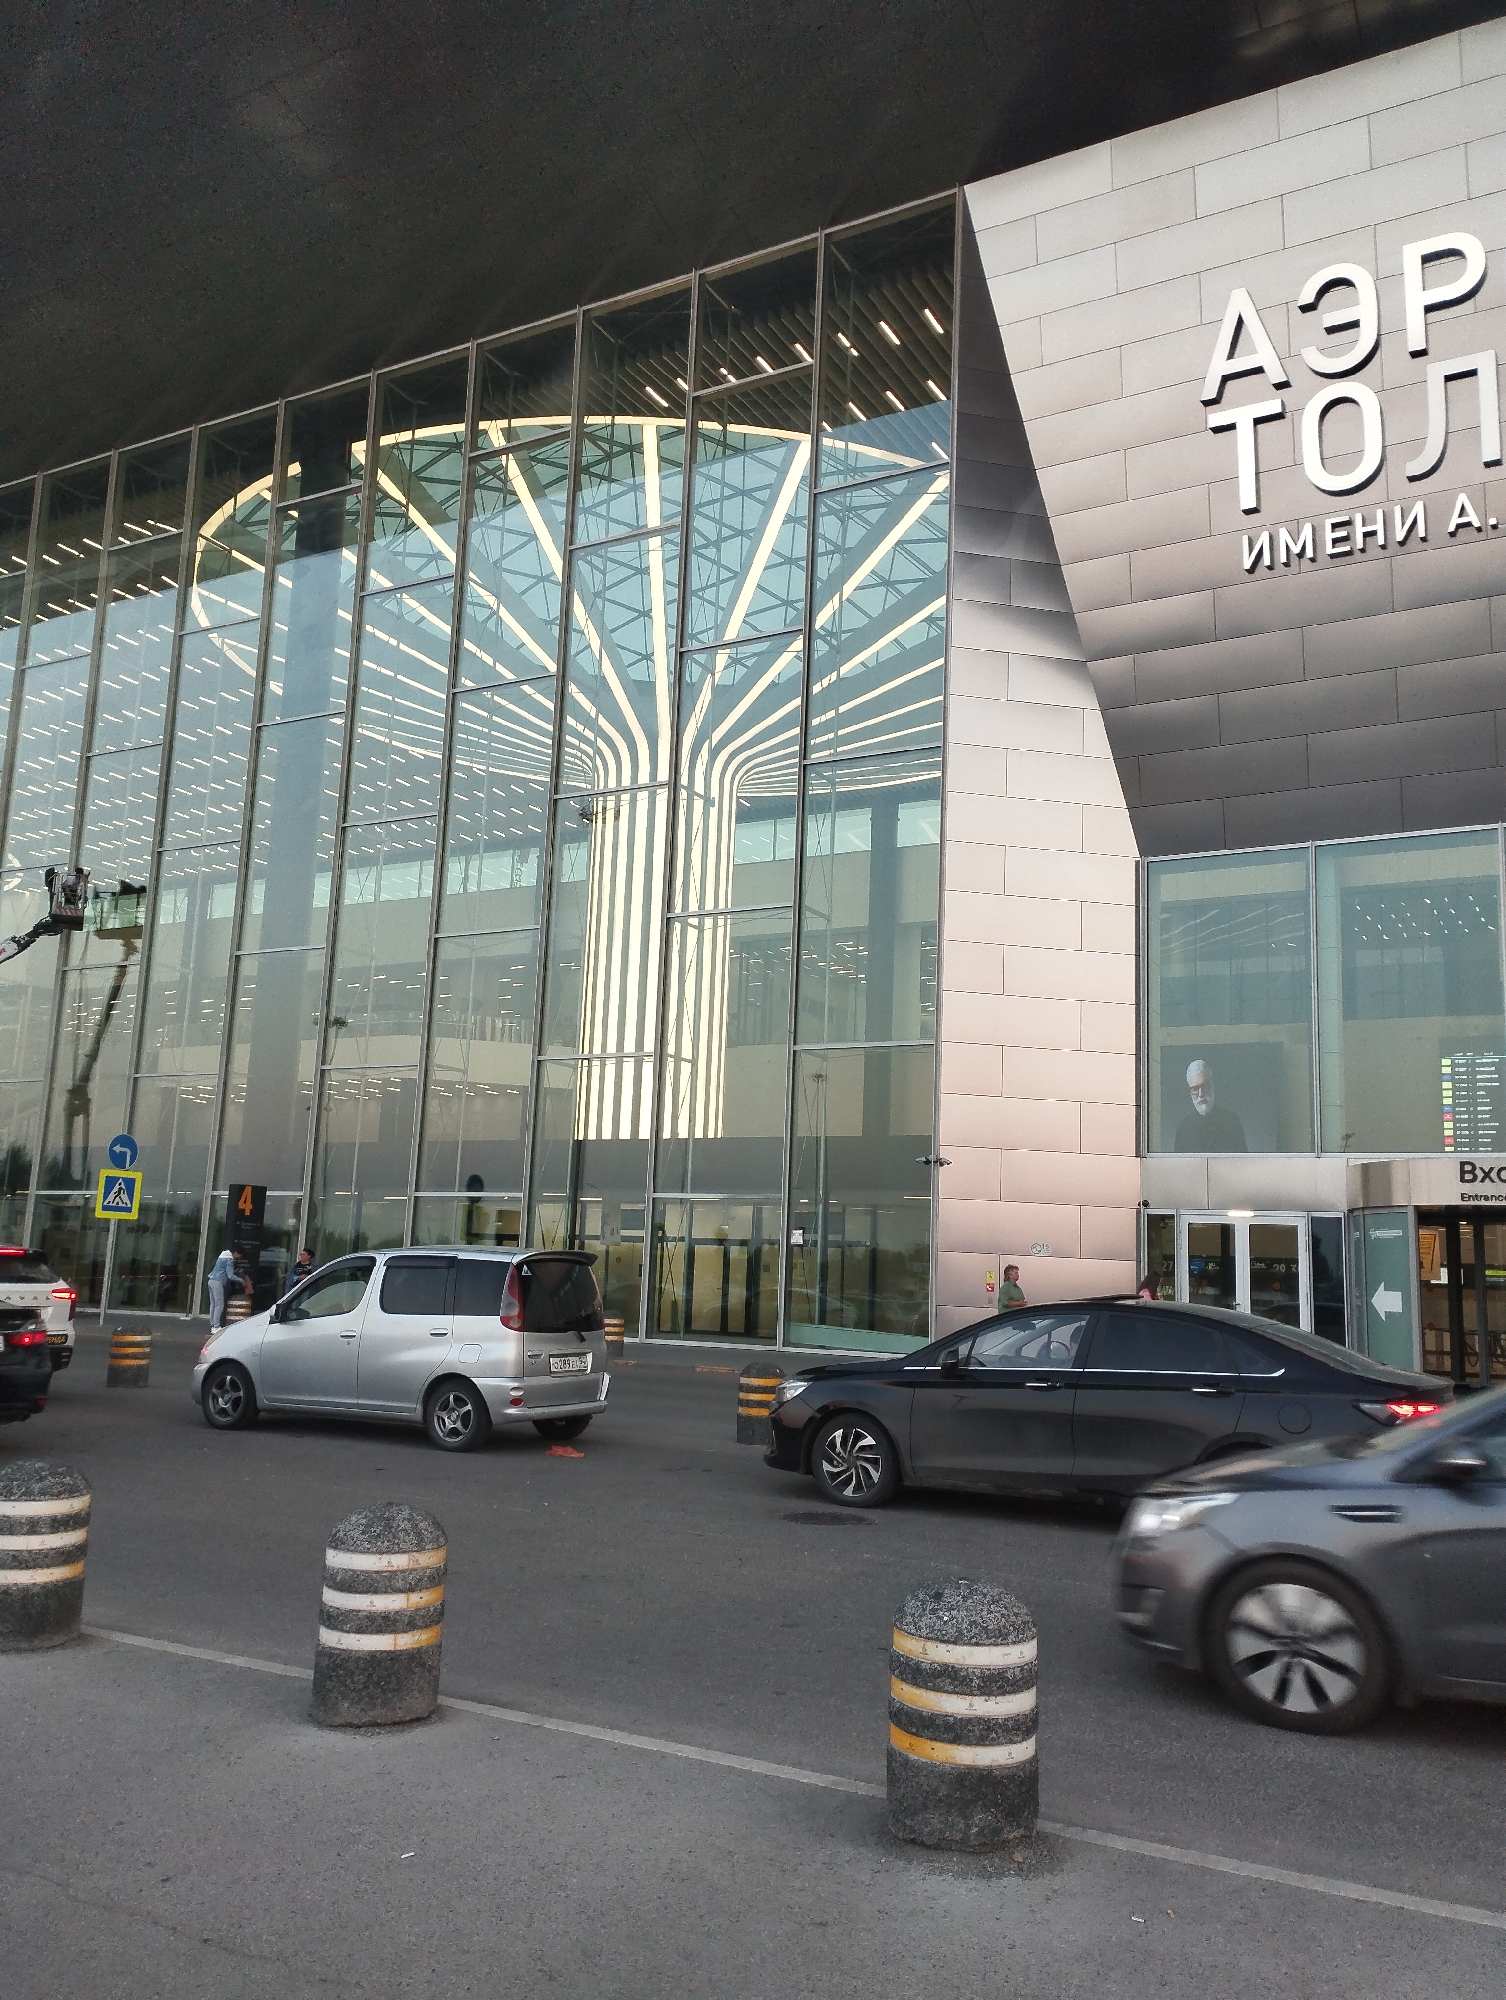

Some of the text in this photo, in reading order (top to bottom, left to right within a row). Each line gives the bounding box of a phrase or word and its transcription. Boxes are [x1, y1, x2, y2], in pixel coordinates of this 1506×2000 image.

[1200, 231, 1488, 406] АЭР
[1207, 350, 1503, 515] ТОЛ
[1242, 492, 1499, 574] ИМЕНИ А.
[238, 1185, 253, 1216] 4
[1460, 1192, 1506, 1202] Entranc
